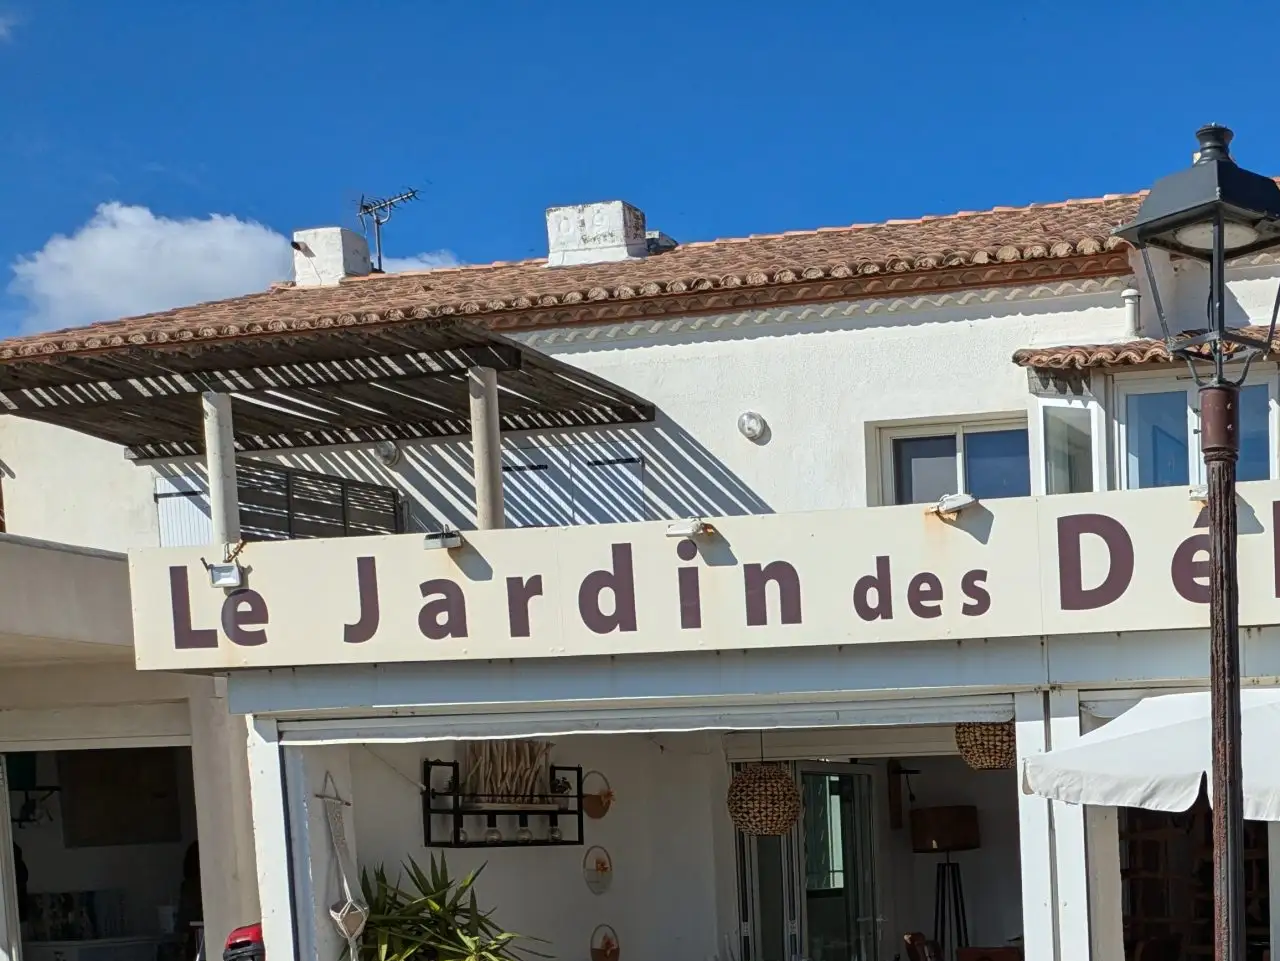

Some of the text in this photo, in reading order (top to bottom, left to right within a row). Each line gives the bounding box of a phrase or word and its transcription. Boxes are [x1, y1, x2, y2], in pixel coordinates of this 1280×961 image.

[168, 565, 269, 650] Le
[343, 539, 803, 645] Jardin
[852, 555, 992, 622] des
